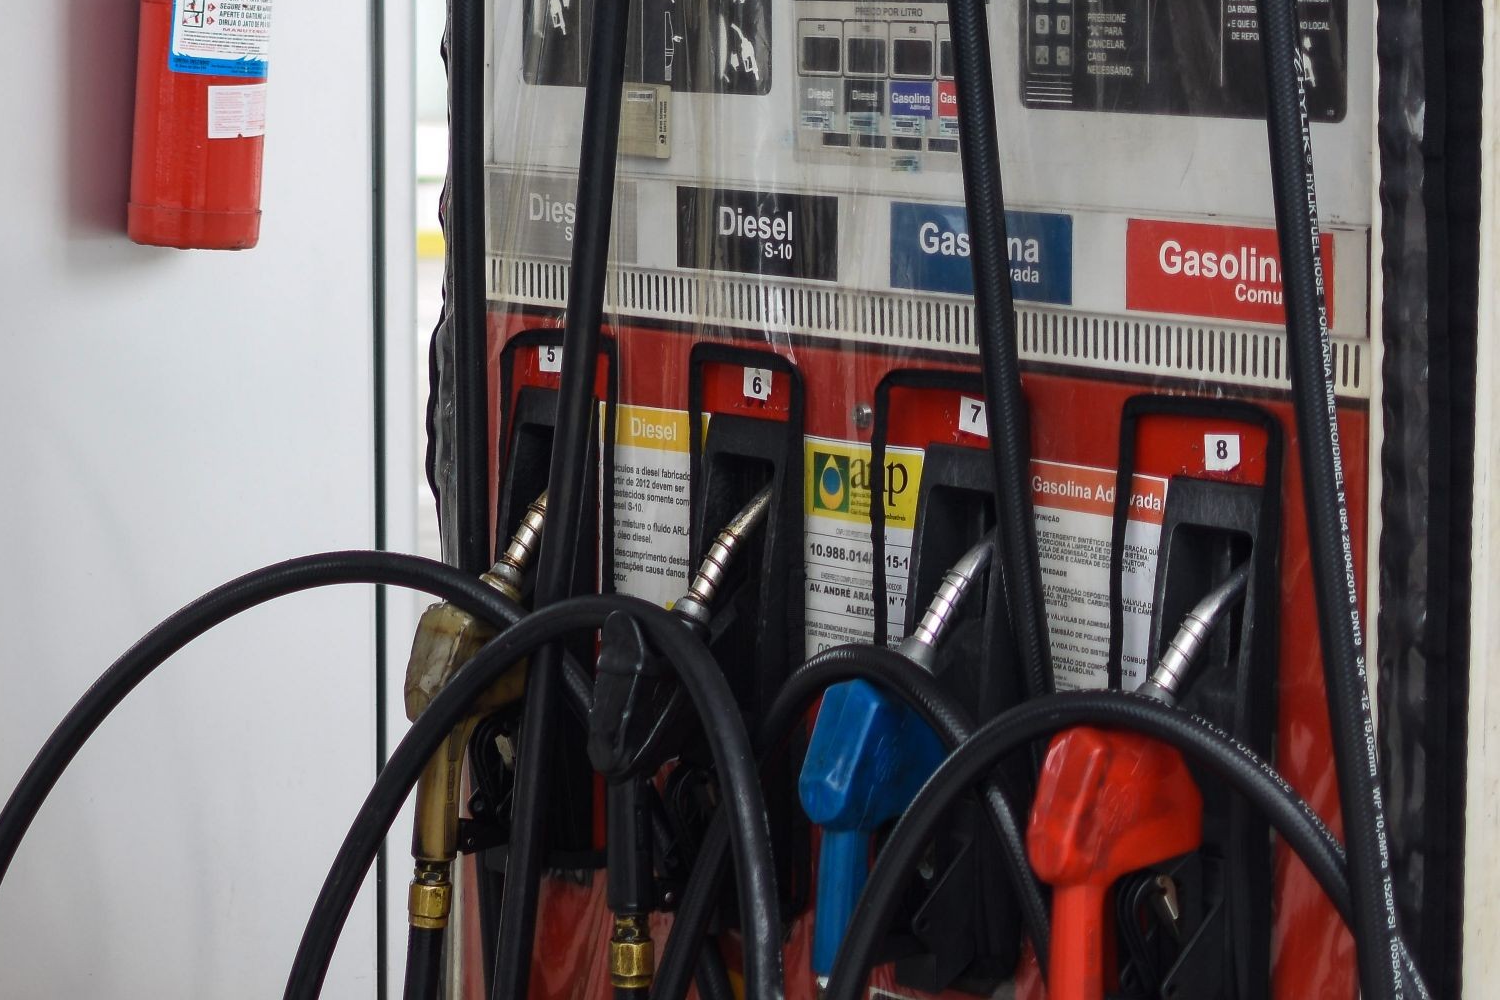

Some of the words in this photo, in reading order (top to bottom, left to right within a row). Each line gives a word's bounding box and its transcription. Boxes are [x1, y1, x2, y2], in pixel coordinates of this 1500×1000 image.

[883, 7, 899, 16] POR
[901, 7, 923, 17] LITRO
[1087, 13, 1127, 24] PRESSIONE
[1228, 5, 1236, 14] DA
[1104, 27, 1123, 36] PARA
[1309, 21, 1330, 30] LOCAL
[1087, 52, 1107, 62] CASO
[808, 88, 834, 99] Diesel
[852, 90, 878, 101] Diesel
[891, 93, 931, 104] Gasolina
[1306, 173, 1318, 215] HYLIK
[529, 193, 575, 225] Dies
[718, 206, 793, 242] Diesel
[1310, 217, 1322, 255] FUEL
[764, 242, 793, 260] S-10
[1158, 240, 1282, 284] Gasolin
[1313, 255, 1325, 297] HOSE
[1234, 284, 1283, 305] Comu
[1318, 306, 1332, 378] PORTARIA
[546, 345, 556, 362] 5
[752, 376, 762, 395] 6
[970, 404, 982, 424] 7
[631, 417, 677, 441] Diesel
[1325, 379, 1344, 488] INMETRO/DIMEL
[1215, 440, 1228, 460] 8
[641, 466, 660, 477] diesel
[626, 477, 634, 487] de
[635, 478, 650, 489] 2012
[652, 481, 673, 492] devem
[674, 485, 685, 493] ser
[1031, 476, 1092, 500] Gasolina
[627, 502, 644, 513] S-10.
[647, 493, 674, 504] somente
[675, 497, 690, 507] com
[621, 518, 646, 530] misture
[1339, 508, 1348, 532] 084
[617, 529, 631, 541] óleo
[632, 532, 653, 544] diesel.
[1042, 531, 1077, 543] DETERGENTE
[1077, 535, 1105, 546] SINTÉTICO
[614, 547, 667, 563] descumprimento
[669, 555, 690, 566] destas
[645, 565, 664, 575] causa
[666, 567, 686, 579] danos
[1341, 533, 1357, 604] 28/04/2016
[809, 583, 822, 593] AV.
[824, 585, 851, 599] ANDRÉ
[1050, 613, 1077, 624] VÁLVULAS
[1050, 627, 1074, 637] EMISSÃO
[1350, 610, 1362, 647] DN19
[1364, 716, 1377, 778] 19,05mm
[1260, 762, 1293, 793] HOSE
[1371, 785, 1383, 811] WP
[1375, 812, 1391, 870] 10,5MPa
[1382, 875, 1397, 938] 1520PSI
[1389, 936, 1403, 991] 105BAR
